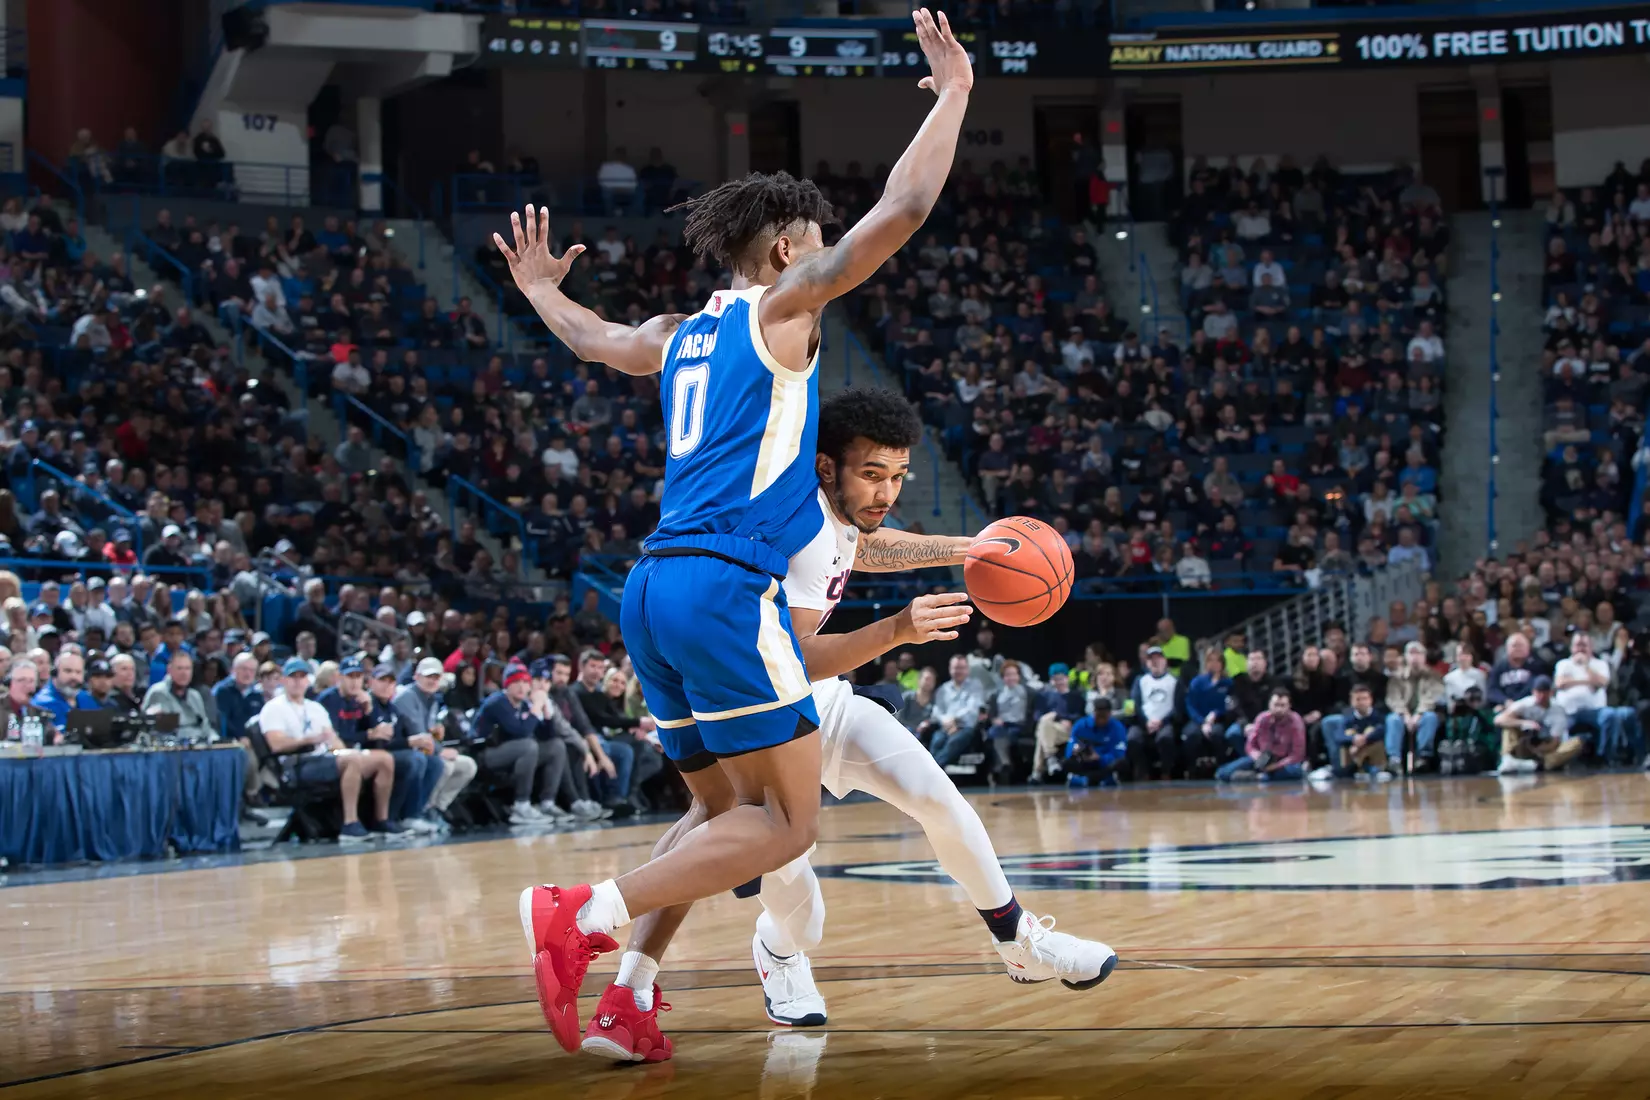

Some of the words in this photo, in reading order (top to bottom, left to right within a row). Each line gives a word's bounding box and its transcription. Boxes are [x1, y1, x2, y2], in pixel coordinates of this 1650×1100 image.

[659, 30, 677, 52] 9
[788, 35, 807, 58] 9
[1110, 46, 1162, 63] ARMY
[1165, 43, 1256, 61] NATIONAL
[1258, 39, 1322, 58] GUARD
[1356, 34, 1427, 60] 100%
[1433, 30, 1508, 57] FREE
[1513, 22, 1623, 52] TUITION
[1629, 20, 1650, 44] T
[1002, 59, 1028, 73] PM
[242, 113, 278, 132] 107
[669, 362, 710, 460] 0
